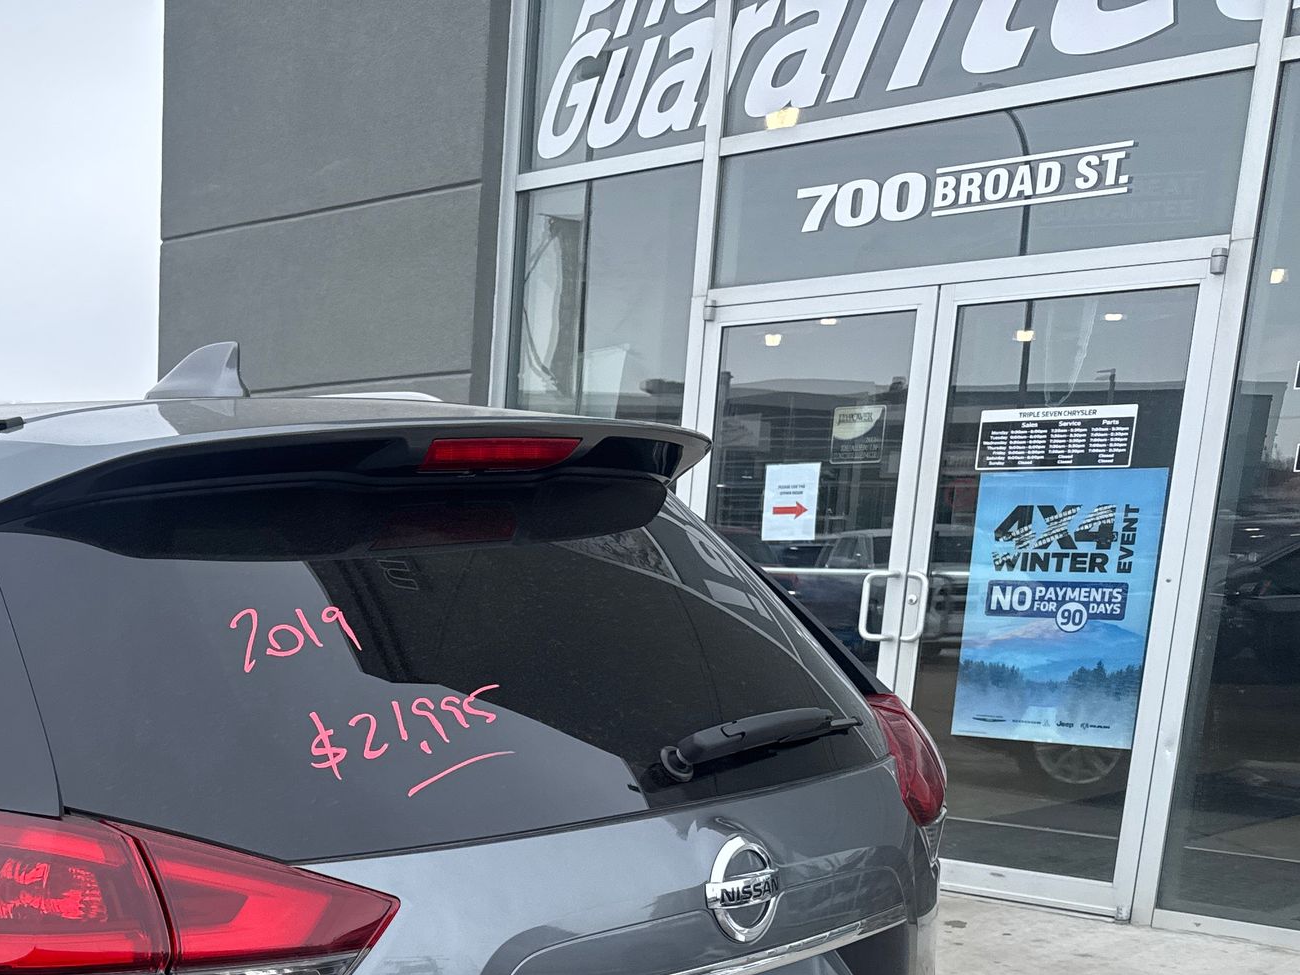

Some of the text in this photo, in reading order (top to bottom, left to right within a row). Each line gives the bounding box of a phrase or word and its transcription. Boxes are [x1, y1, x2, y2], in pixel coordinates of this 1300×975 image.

[538, 0, 1300, 159] Guaran
[797, 172, 927, 232] 700
[933, 160, 1061, 208] BROAD
[1075, 151, 1129, 190] ST.
[1063, 409, 1097, 417] CHRYSLER
[994, 504, 1118, 550] 4X4
[1117, 504, 1139, 573] EVENT
[992, 552, 1109, 573] WINTER
[990, 585, 1123, 611] NO PAYMENTS
[1033, 601, 1121, 626] FOR 90 DAYS
[230, 606, 362, 672] 2019
[309, 684, 499, 780] $21,995
[720, 876, 780, 904] NISSAN
